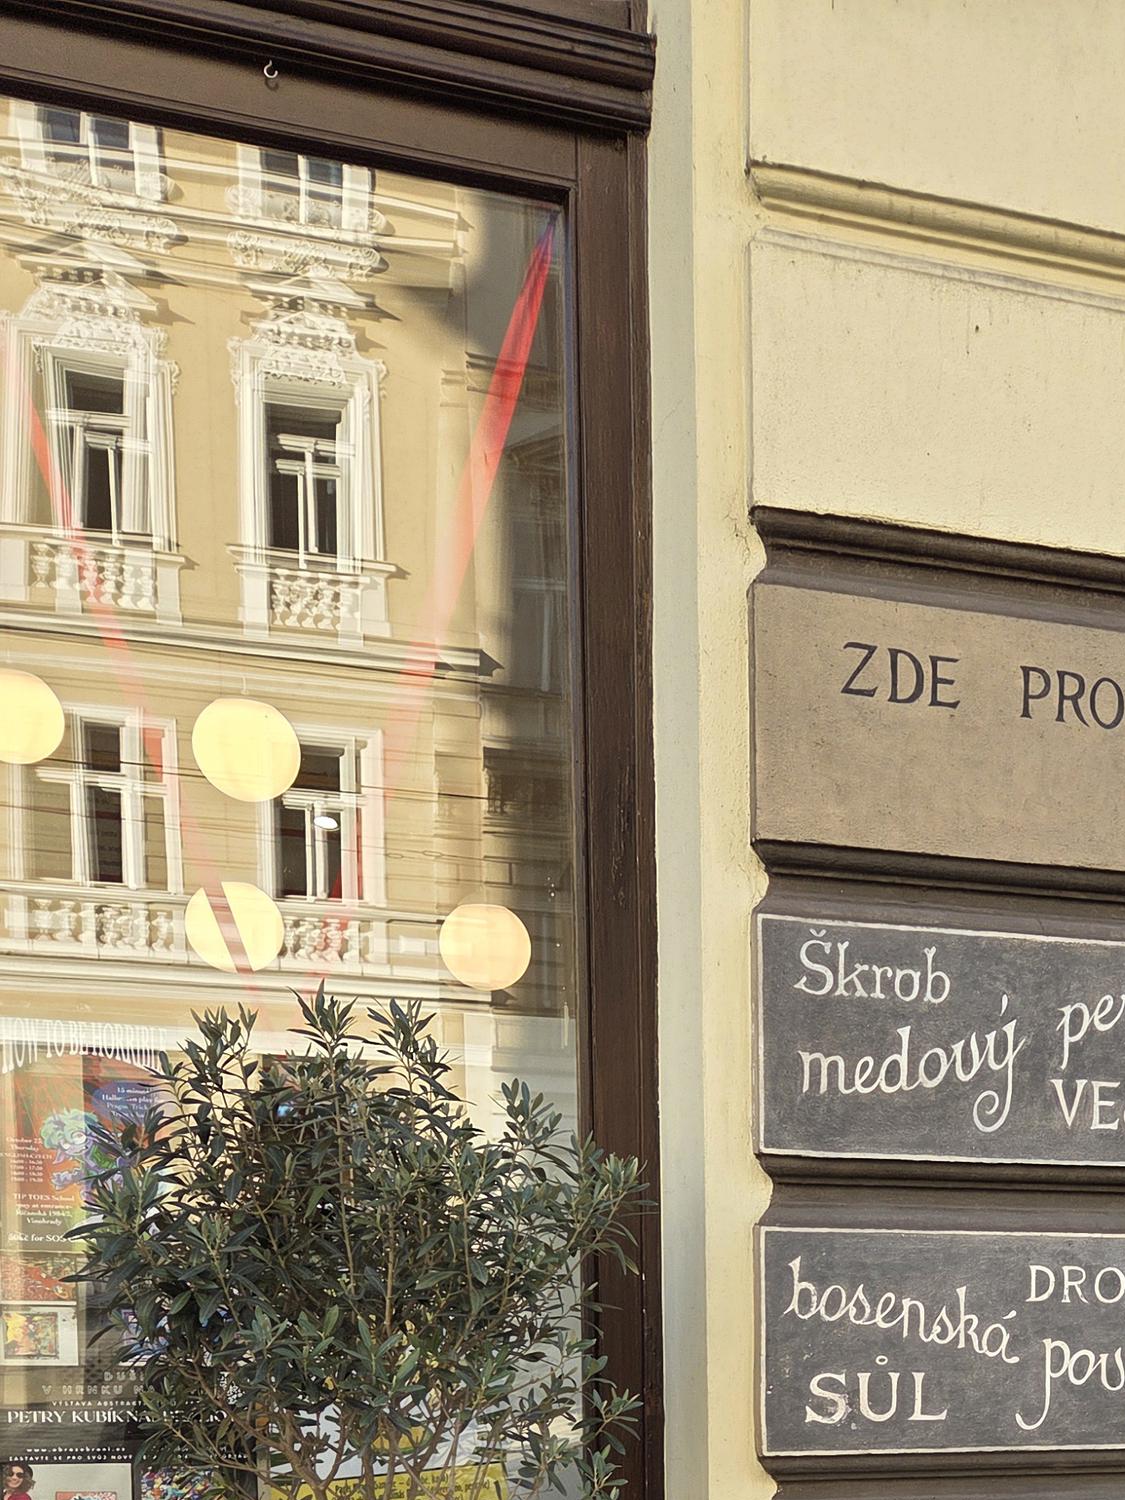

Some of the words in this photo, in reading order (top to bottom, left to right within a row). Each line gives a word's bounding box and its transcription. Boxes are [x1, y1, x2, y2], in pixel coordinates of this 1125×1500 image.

[840, 641, 961, 710] ZDE
[794, 928, 951, 1005] Škrob
[797, 995, 1026, 1133] medový
[783, 1255, 1020, 1364] bosenská
[805, 1354, 948, 1424] SŮL
